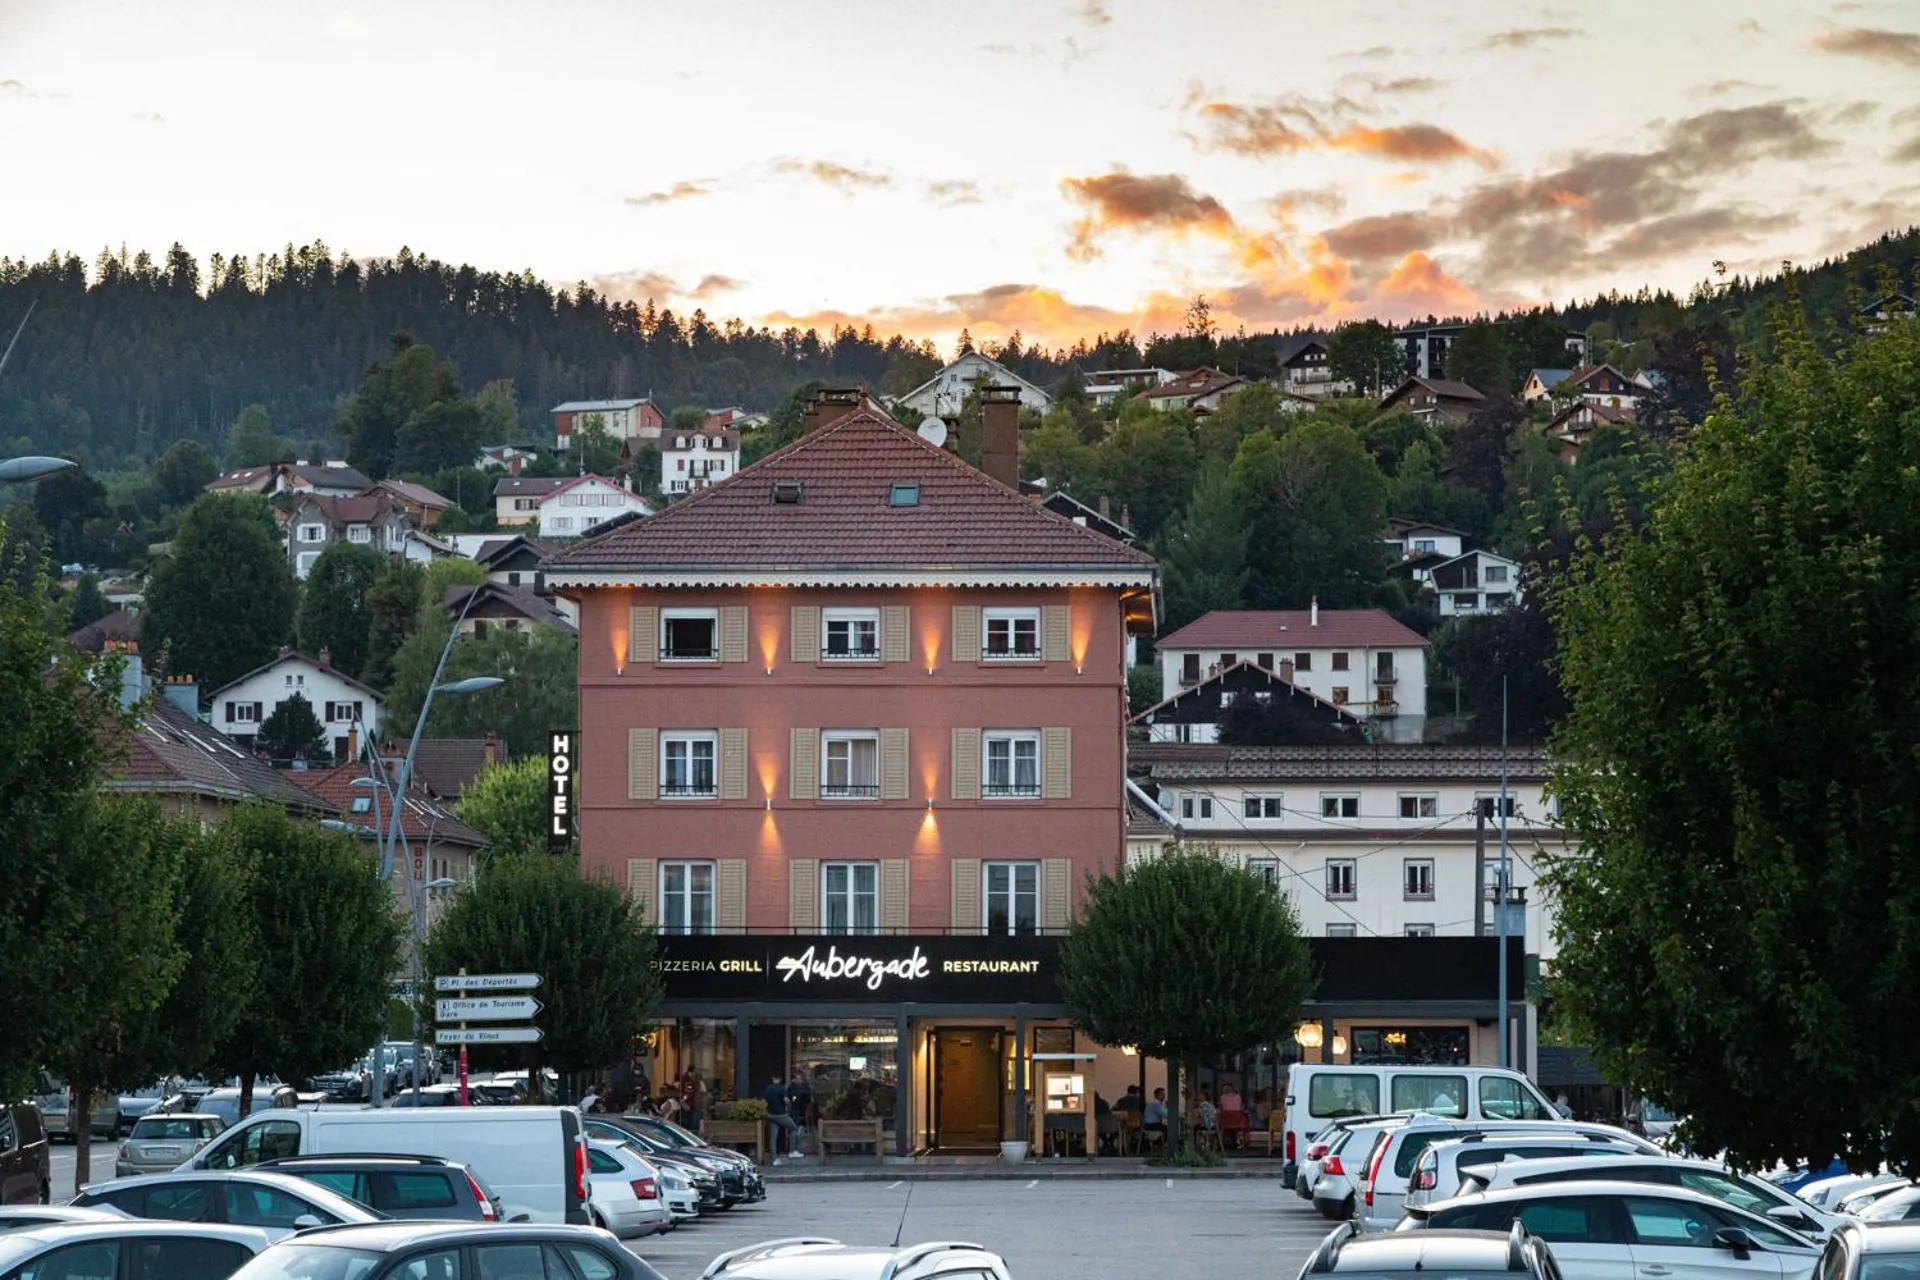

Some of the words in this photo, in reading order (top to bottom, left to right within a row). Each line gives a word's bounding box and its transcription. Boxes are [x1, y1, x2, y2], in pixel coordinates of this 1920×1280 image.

[552, 734, 570, 835] HOTEL
[649, 960, 716, 972] PIZZERIA
[719, 960, 763, 972] GRILL
[776, 945, 930, 990] Aubergade
[943, 960, 1040, 973] RESTAURANT
[452, 1000, 476, 1009] Office
[493, 999, 526, 1008] Tourisme
[439, 1010, 458, 1018] Gare
[439, 1032, 461, 1041] Foyer
[464, 1032, 474, 1040] du
